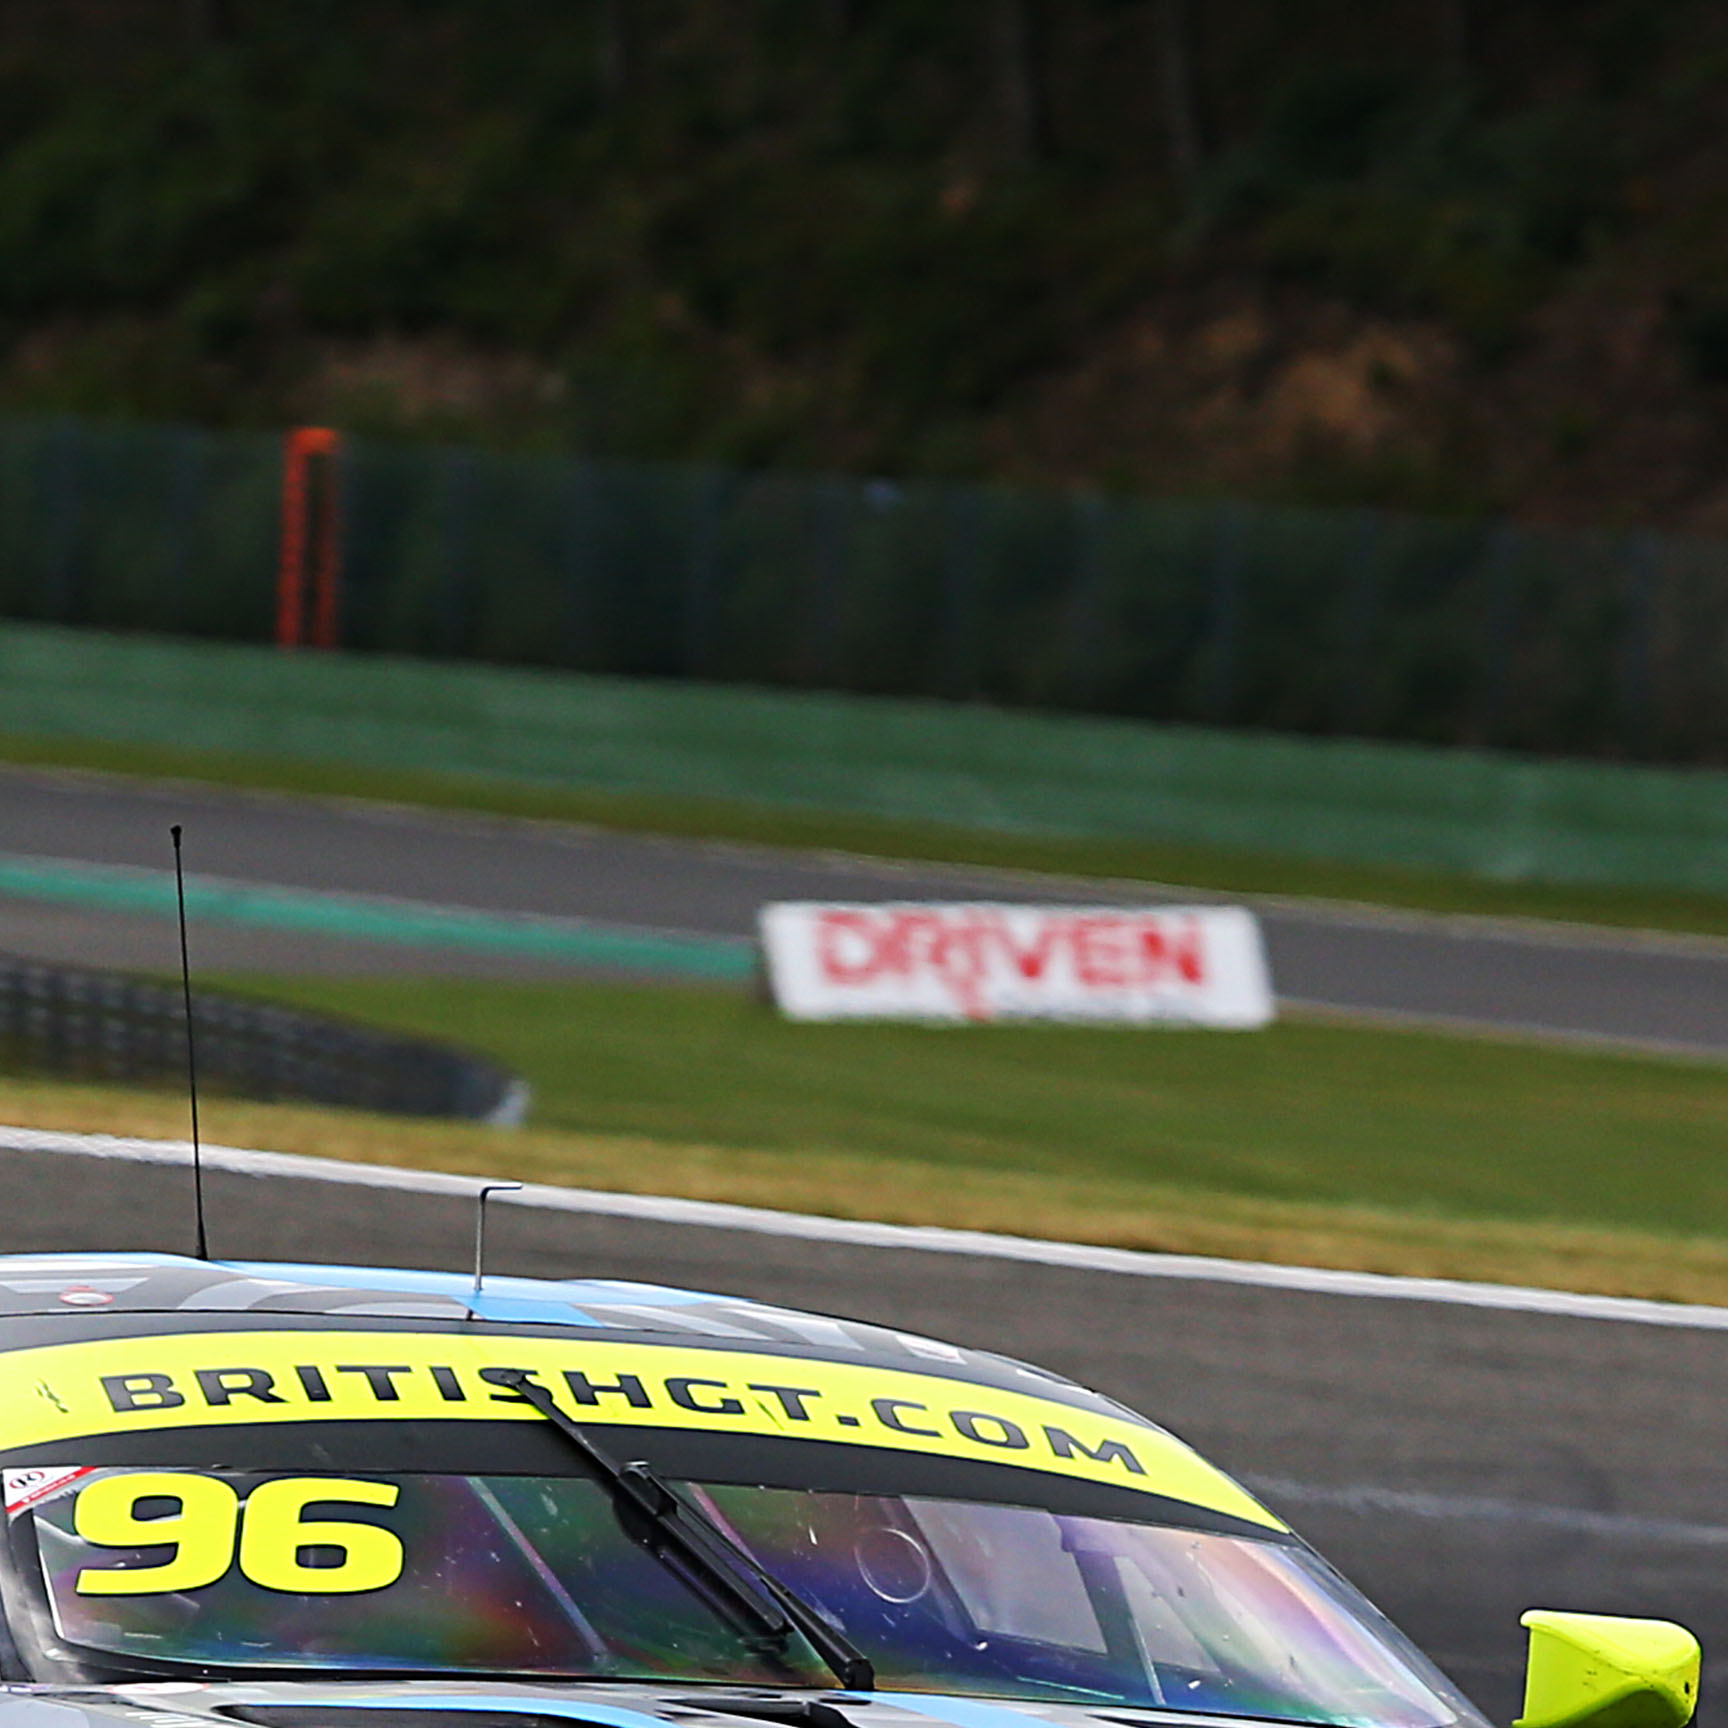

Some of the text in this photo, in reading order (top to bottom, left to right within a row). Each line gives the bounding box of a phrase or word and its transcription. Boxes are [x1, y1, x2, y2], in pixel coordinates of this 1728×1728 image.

[814, 908, 1206, 1021] DRIVEN
[99, 1364, 1149, 1478] BRITISHGT.COM
[73, 1472, 405, 1597] 96
